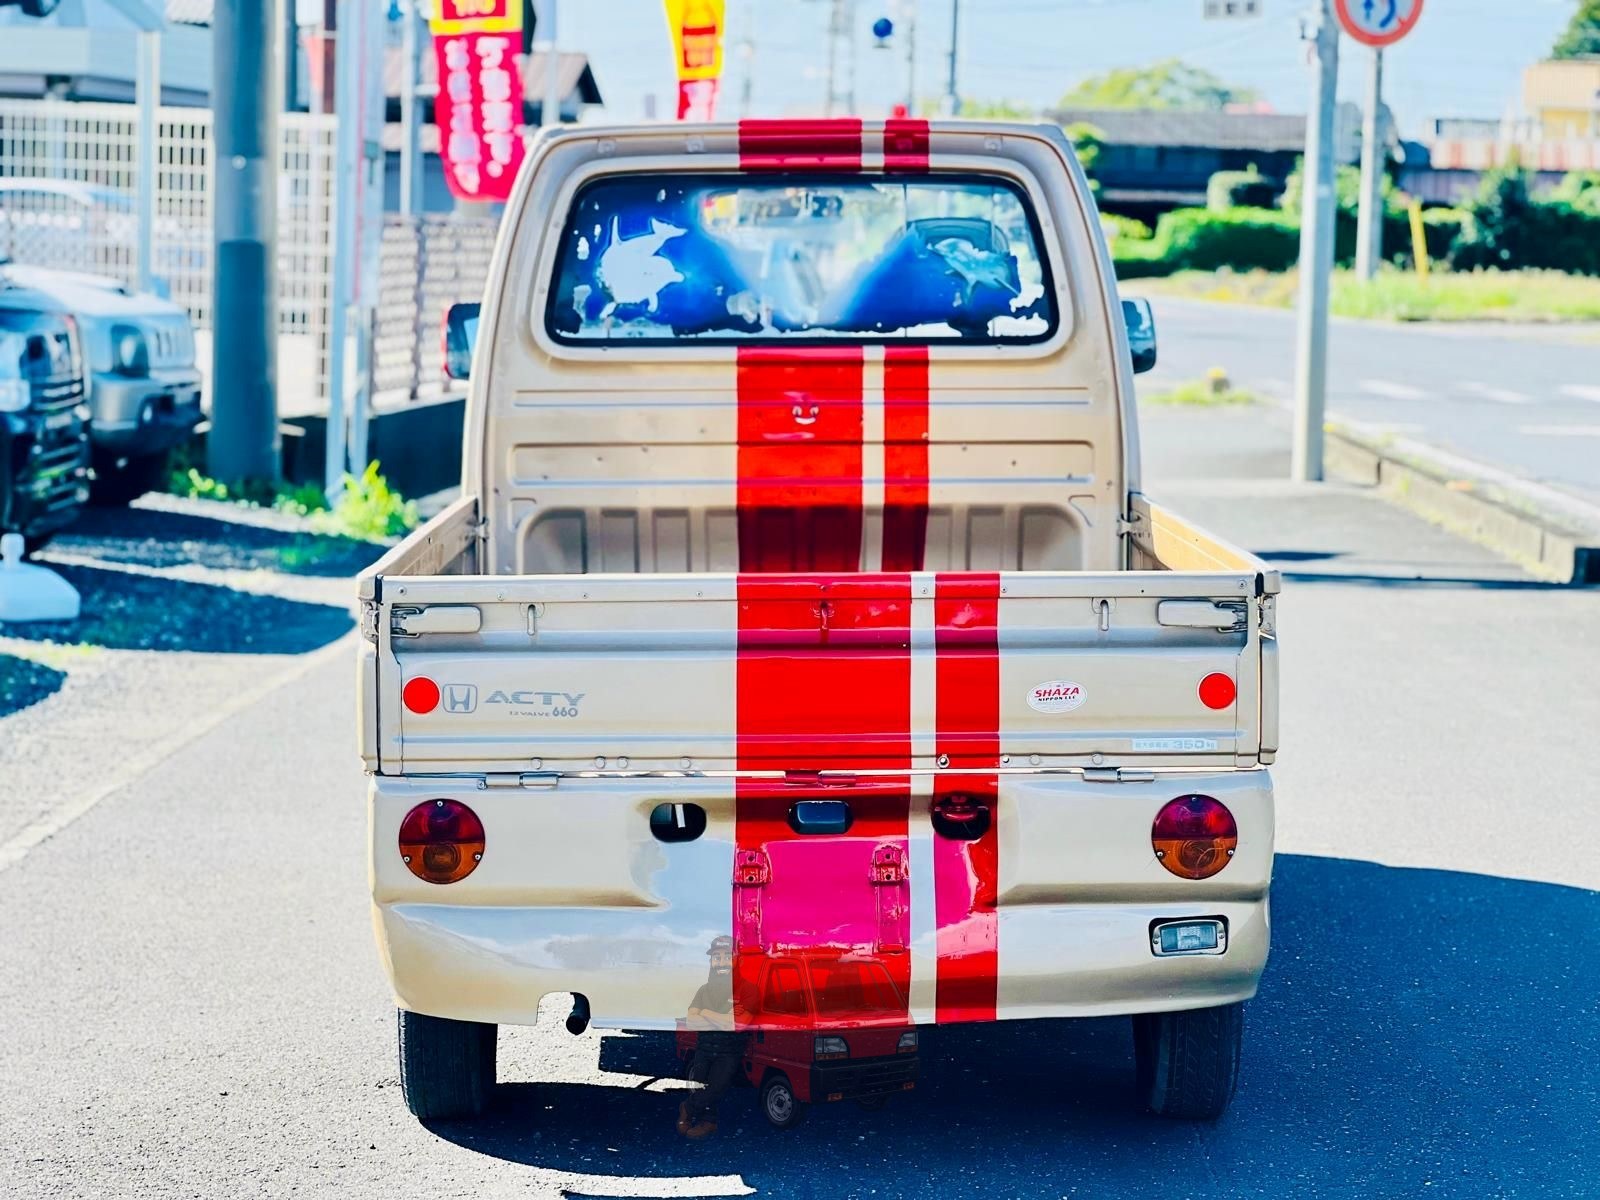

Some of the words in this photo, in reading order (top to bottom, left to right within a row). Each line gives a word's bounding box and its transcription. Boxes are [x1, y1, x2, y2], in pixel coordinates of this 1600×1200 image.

[484, 690, 586, 706] ACTY
[1034, 687, 1080, 698] SHAZA
[552, 706, 579, 718] 660
[1173, 740, 1205, 749] 350
